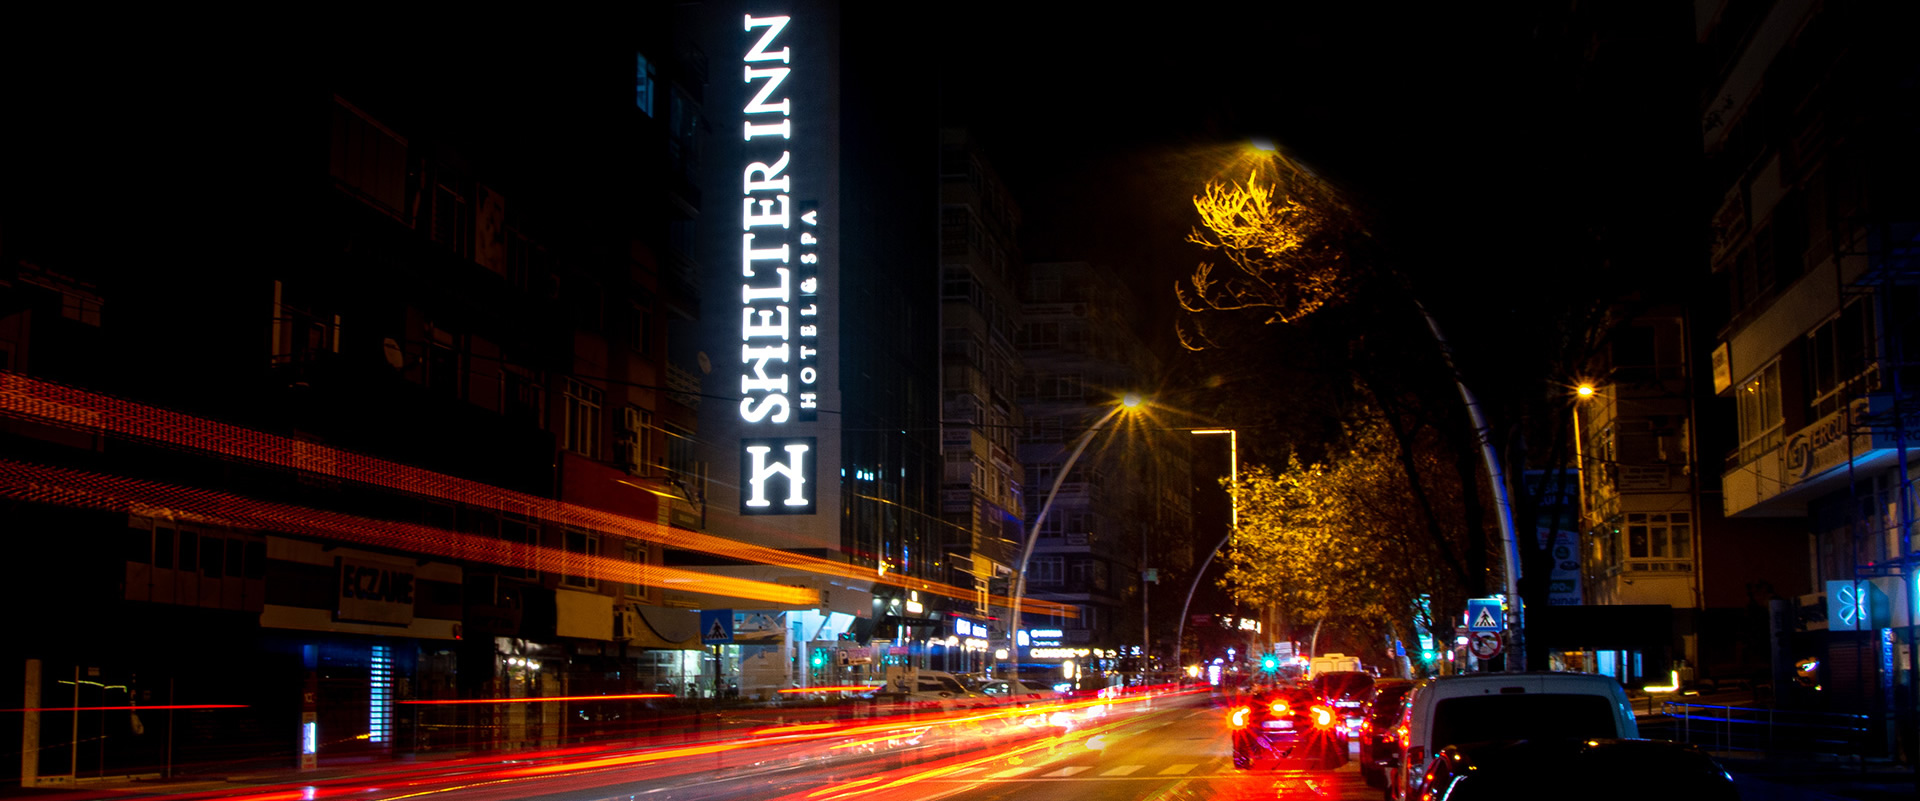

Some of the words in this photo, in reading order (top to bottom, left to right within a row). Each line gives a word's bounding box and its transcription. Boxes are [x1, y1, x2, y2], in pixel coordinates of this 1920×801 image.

[743, 13, 791, 141] INN
[800, 210, 818, 264] SPA
[740, 150, 790, 424] SHELTER
[800, 276, 818, 294] &
[800, 303, 818, 409] HOTEL
[745, 443, 810, 508] H
[343, 564, 414, 604] ECZANE
